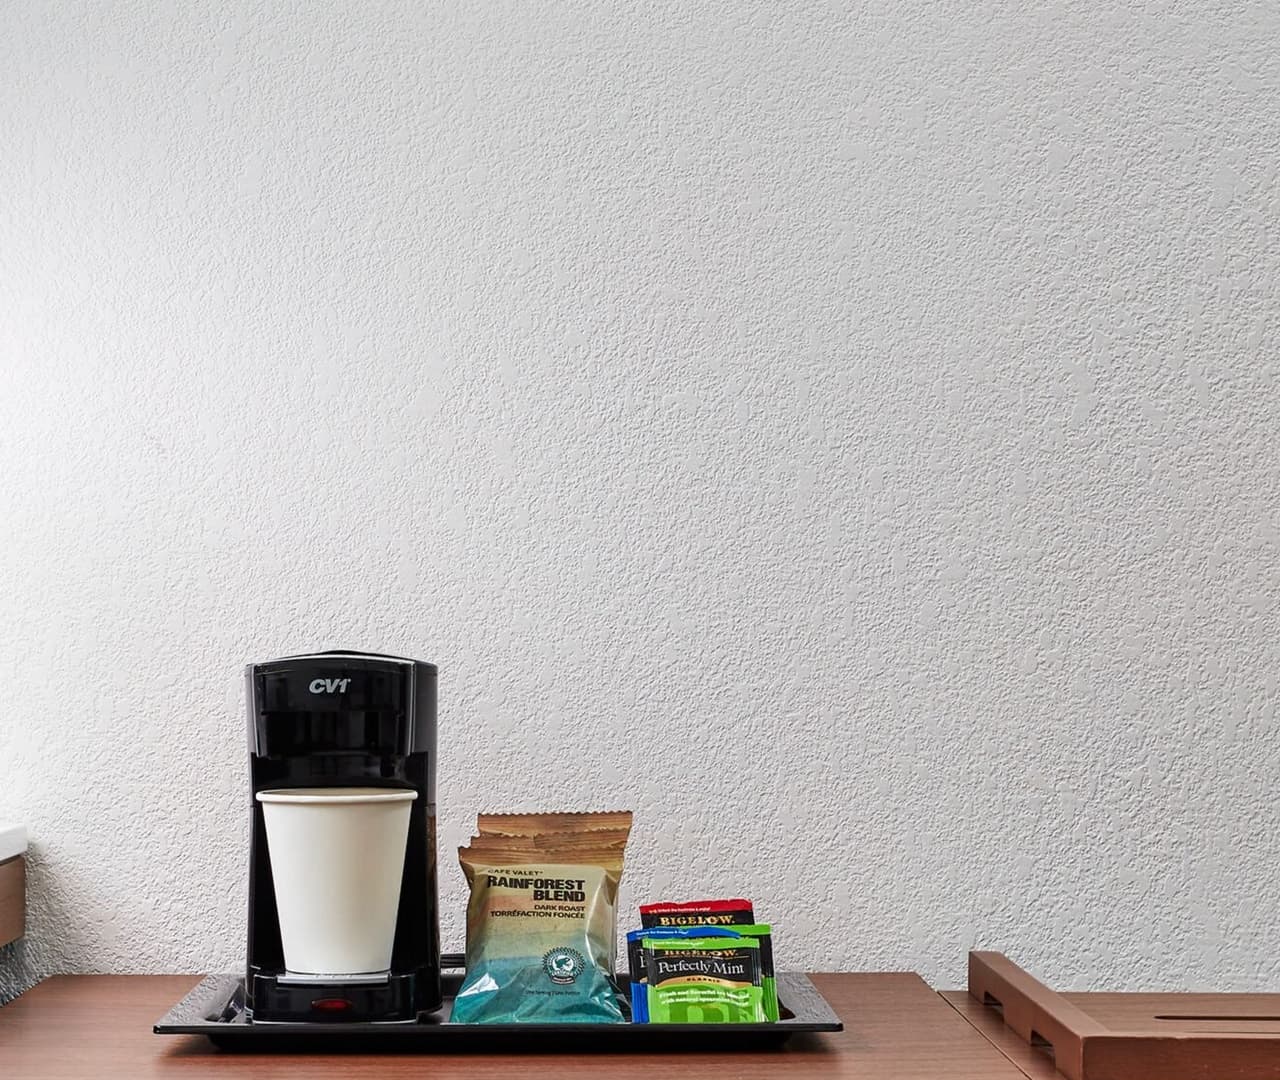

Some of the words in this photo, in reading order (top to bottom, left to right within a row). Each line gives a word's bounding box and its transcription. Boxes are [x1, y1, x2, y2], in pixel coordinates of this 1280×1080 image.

[309, 678, 349, 694] CV1
[487, 875, 586, 890] RAINFOREST
[533, 890, 586, 902] BLEND
[490, 909, 552, 918] TORRÉFACTION
[553, 911, 585, 919] FONCÉE
[660, 915, 733, 926] BIGELOW
[658, 960, 711, 974] Perfectly
[713, 961, 744, 975] Mint
